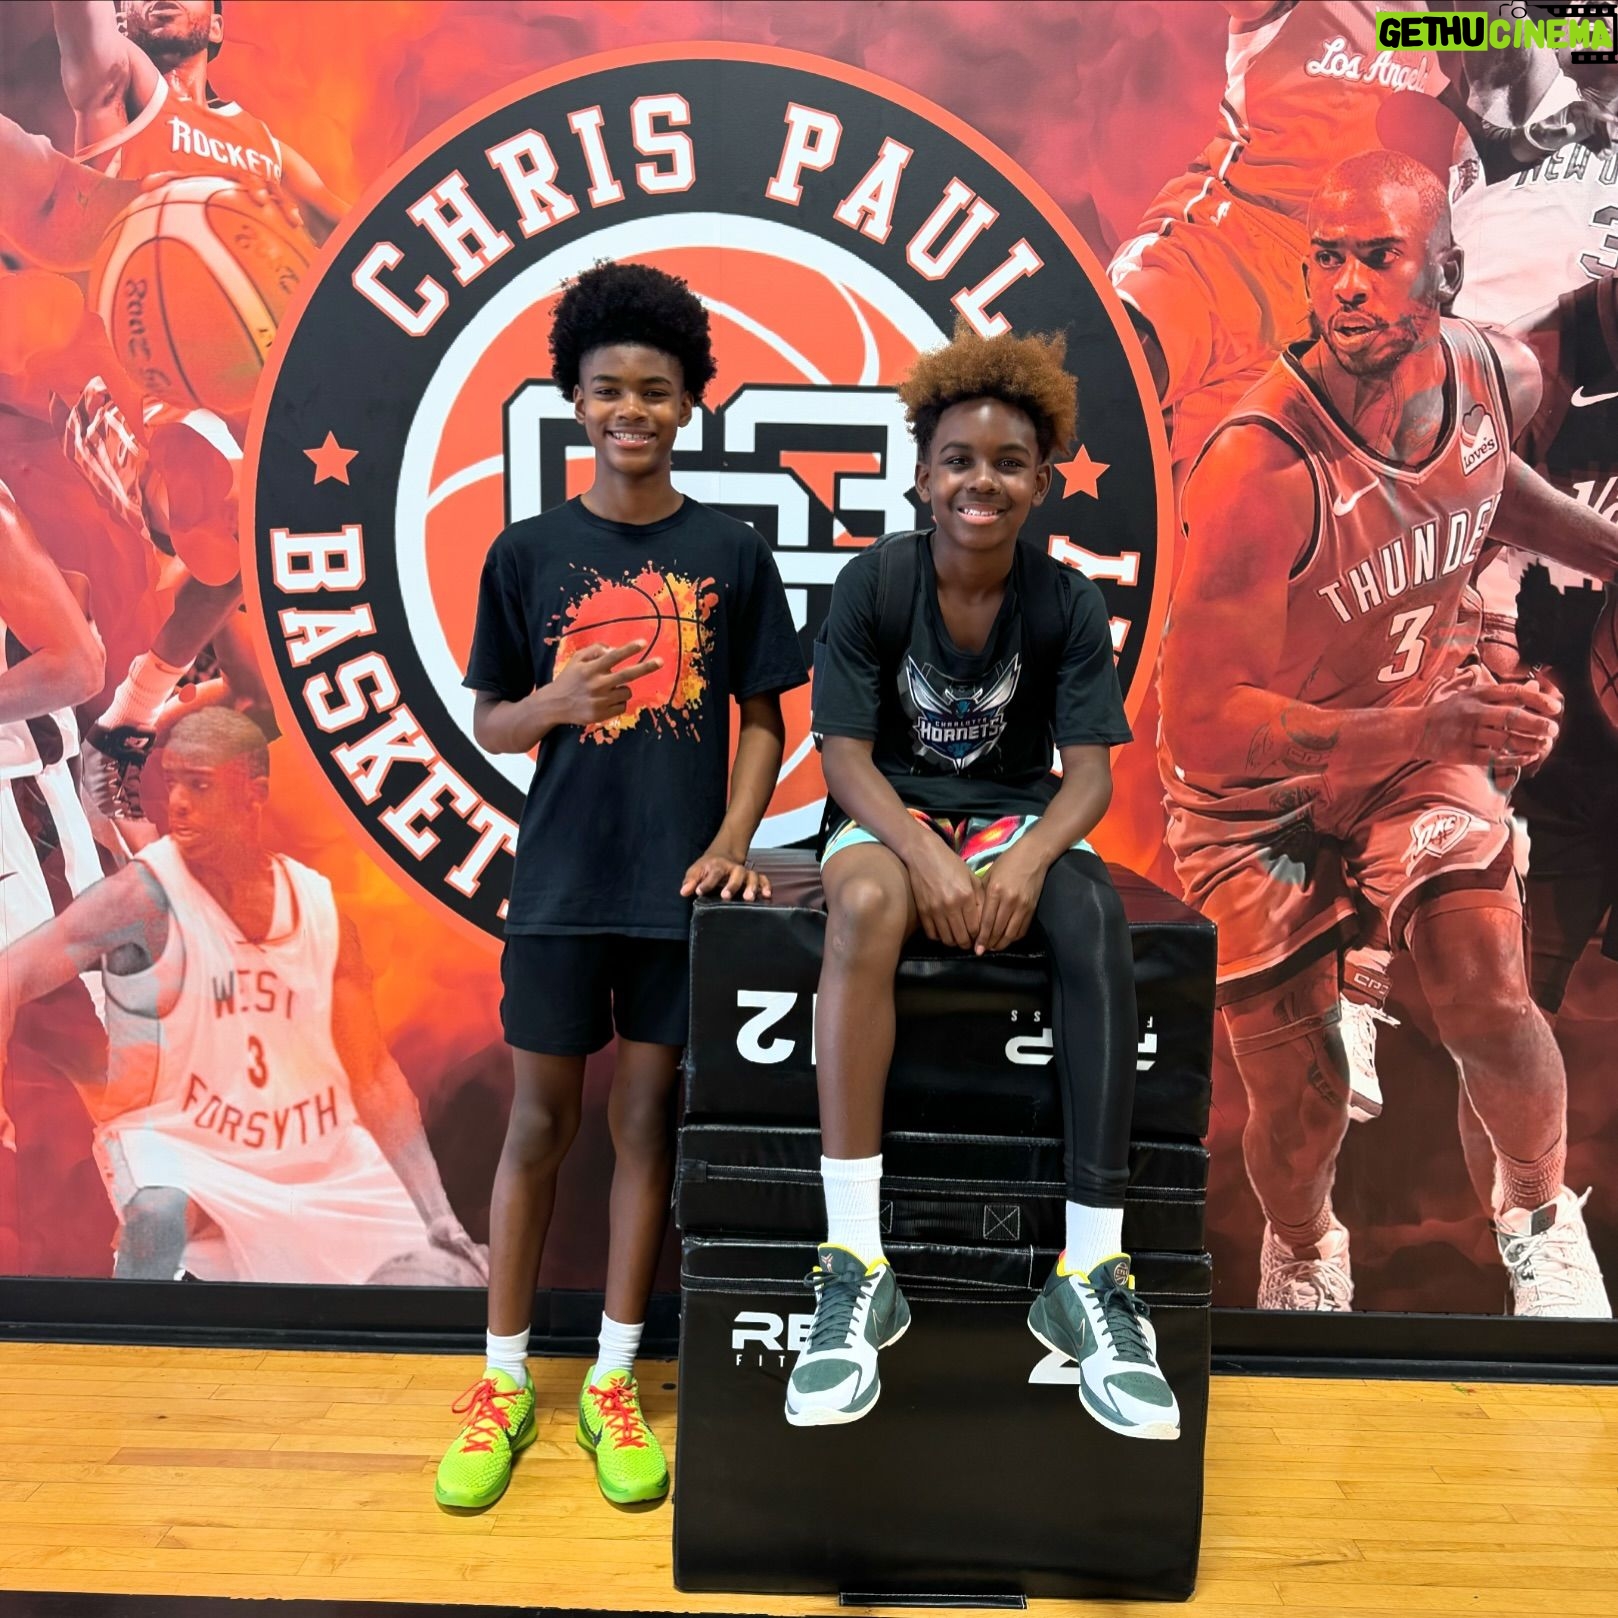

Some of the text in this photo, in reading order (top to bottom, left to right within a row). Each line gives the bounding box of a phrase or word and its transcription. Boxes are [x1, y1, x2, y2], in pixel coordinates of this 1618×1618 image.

[1304, 36, 1428, 93] Los Angel
[351, 93, 696, 337] CHRIS
[765, 102, 1045, 337] PAUL
[1318, 498, 1494, 624] THUNDE
[1377, 604, 1436, 684] 3
[269, 524, 521, 920] BASKET
[919, 717, 1002, 743] HORNETS
[247, 1035, 268, 1089] 3
[181, 1072, 338, 1151] FORSYTH
[731, 1311, 817, 1351] RE
[736, 1353, 786, 1368] FIT
